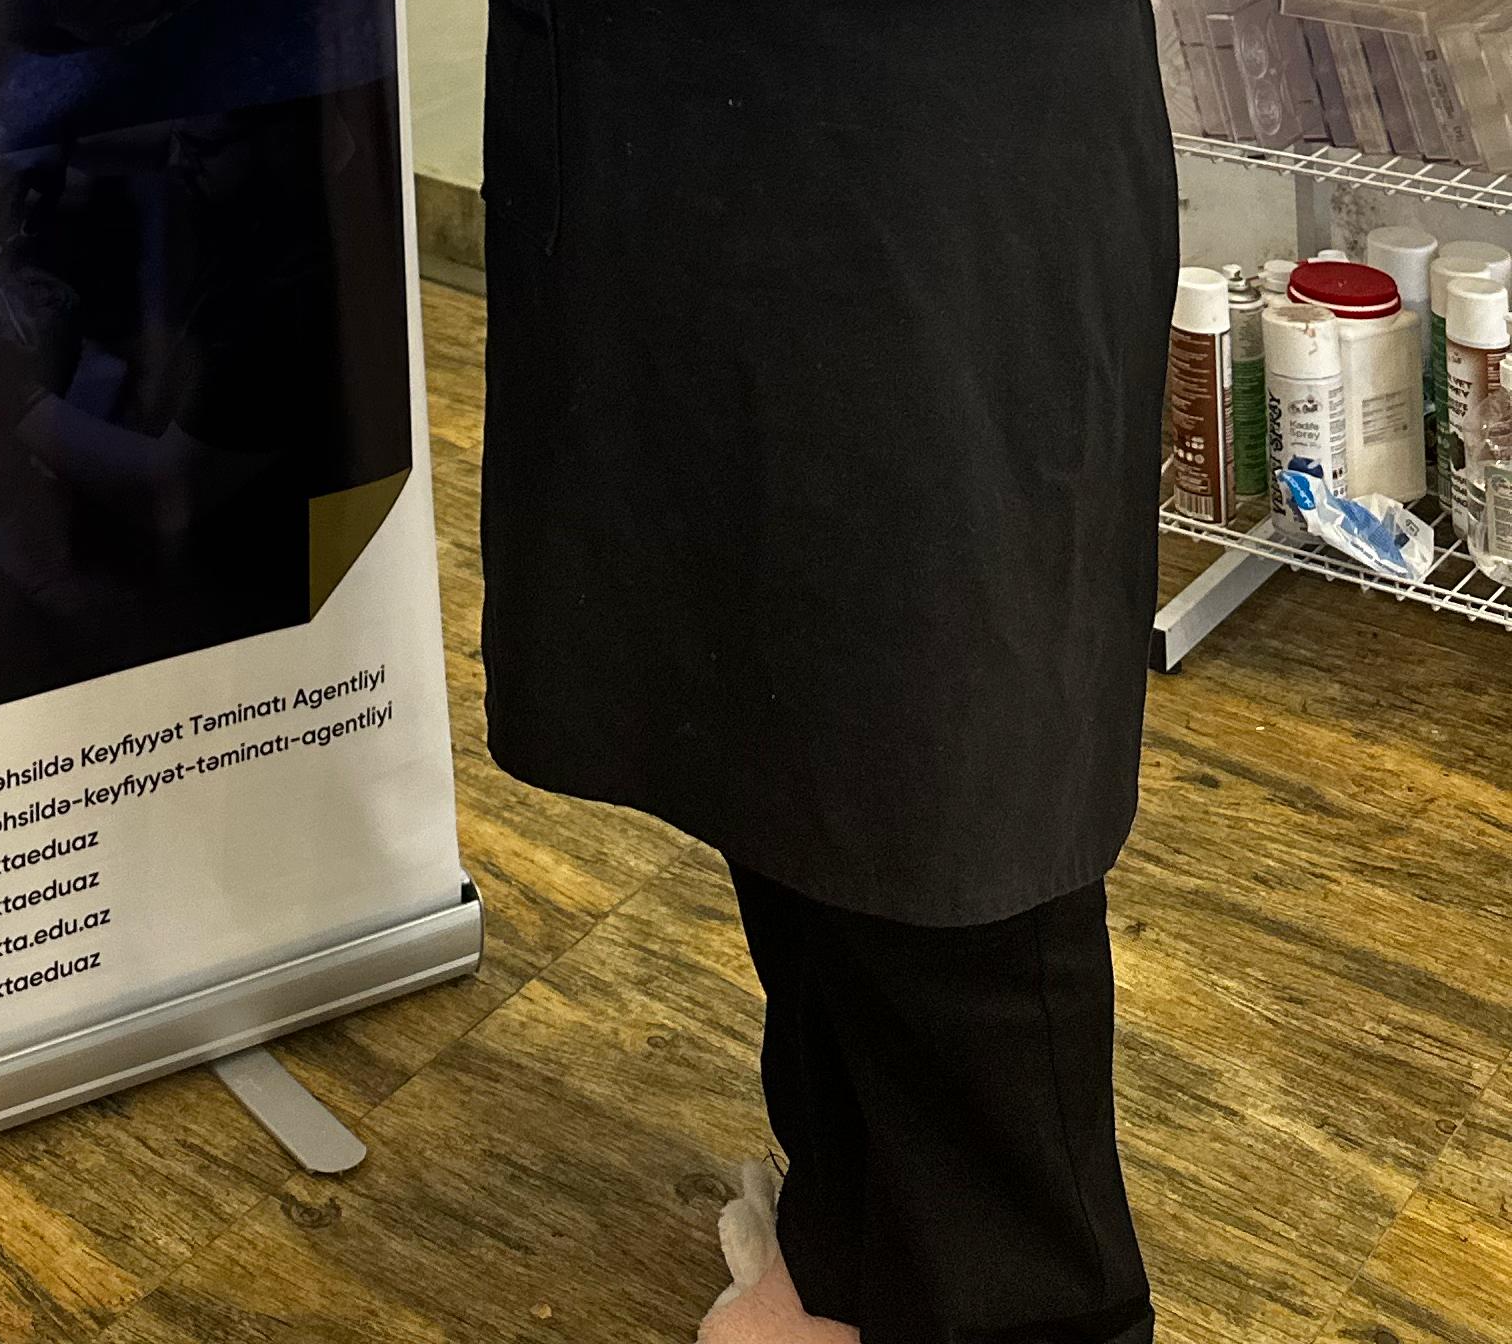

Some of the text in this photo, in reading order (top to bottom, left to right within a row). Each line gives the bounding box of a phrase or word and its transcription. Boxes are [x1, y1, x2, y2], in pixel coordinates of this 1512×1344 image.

[80, 723, 184, 768] Keyfiyyət
[189, 697, 287, 736] Təminatı
[293, 665, 386, 711] Agentliyi
